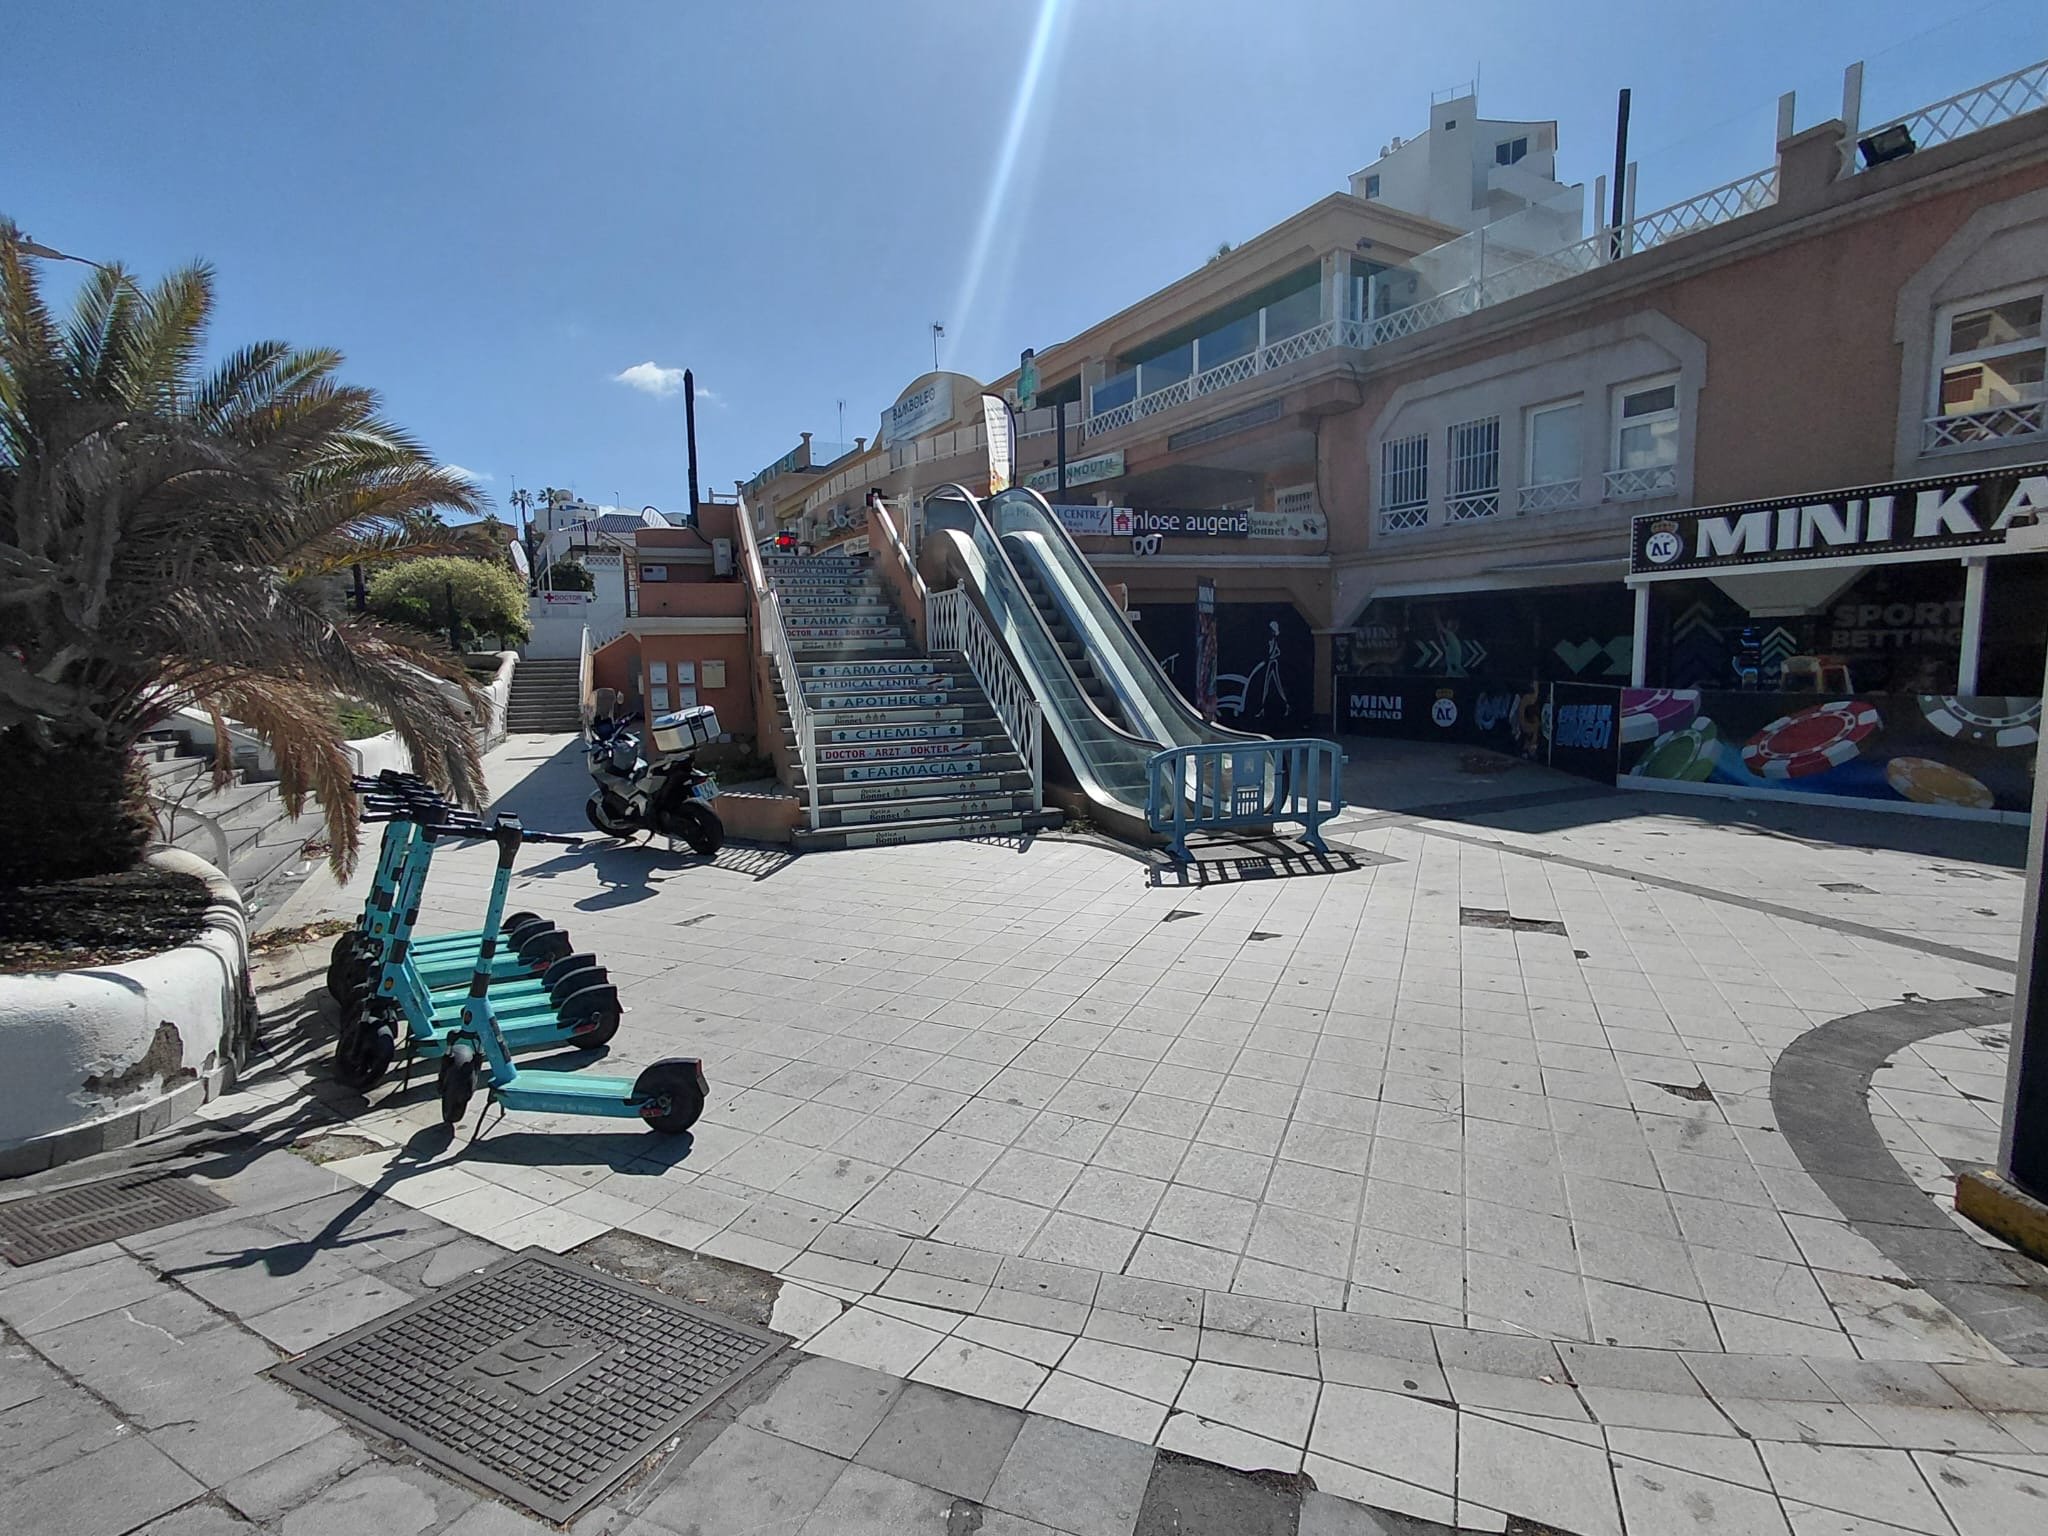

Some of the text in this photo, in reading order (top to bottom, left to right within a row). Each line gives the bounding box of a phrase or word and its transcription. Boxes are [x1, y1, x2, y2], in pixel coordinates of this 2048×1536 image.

[892, 387, 936, 421] BAMBOLEO
[1031, 458, 1113, 487] COTTNMOUTH
[1064, 509, 1101, 520] CENTRE
[1133, 510, 1248, 536] nlose augenä
[1696, 495, 1895, 558] MINI
[798, 597, 859, 605] CHEMIST
[1833, 601, 1964, 627] SPORT
[803, 617, 870, 626] FARMACIA
[787, 629, 811, 637] OCTOR
[1832, 627, 1961, 649] BETTING
[834, 664, 913, 676] FARMACIA
[823, 678, 920, 689] MEDICAL CENTRE
[844, 694, 927, 708] APOTHEKE
[1350, 694, 1402, 710] MINI
[1350, 709, 1402, 721] KASINO
[856, 726, 940, 740] CHEMIST
[825, 745, 950, 760] DOCTOR ARZT DOKTER
[868, 763, 957, 778] FARMACIA
